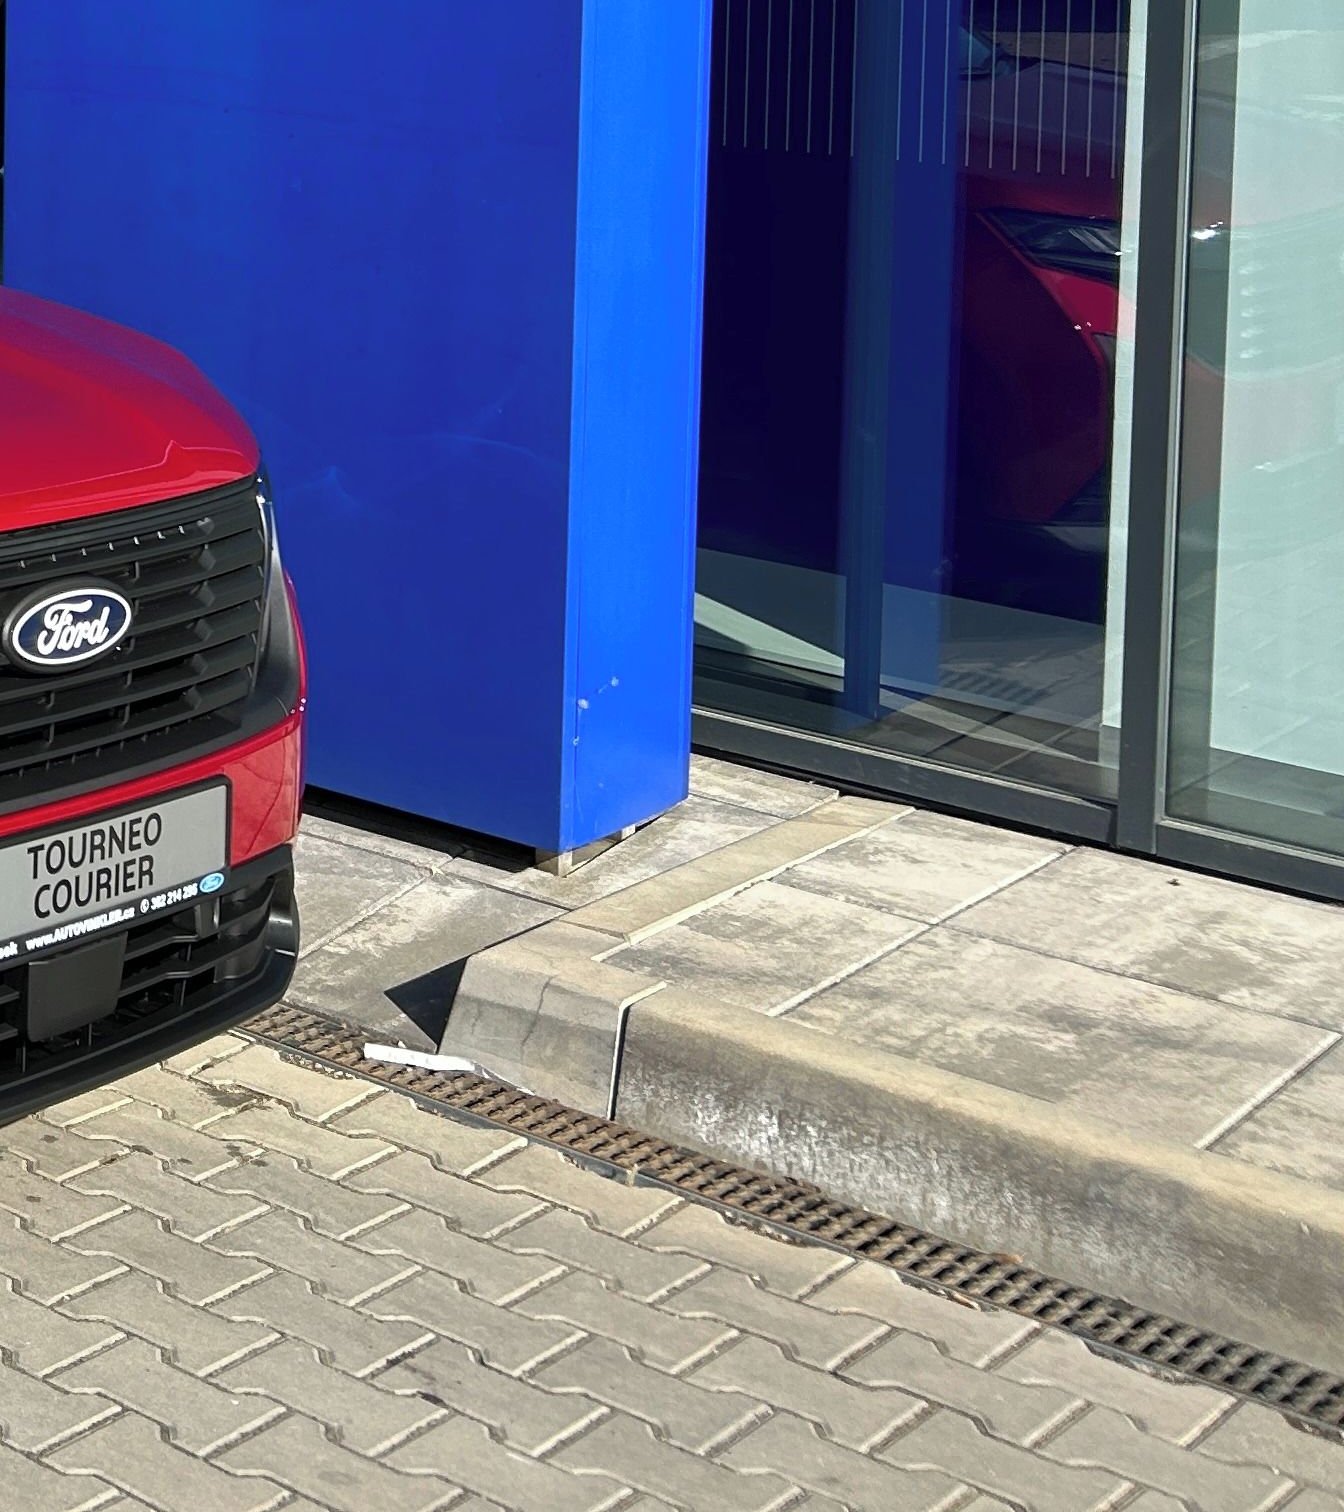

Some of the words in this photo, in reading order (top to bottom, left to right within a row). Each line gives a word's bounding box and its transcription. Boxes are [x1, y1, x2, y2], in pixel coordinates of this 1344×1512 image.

[37, 599, 110, 655] Ford
[27, 812, 162, 880] TOURNEO
[34, 855, 154, 919] COURIER
